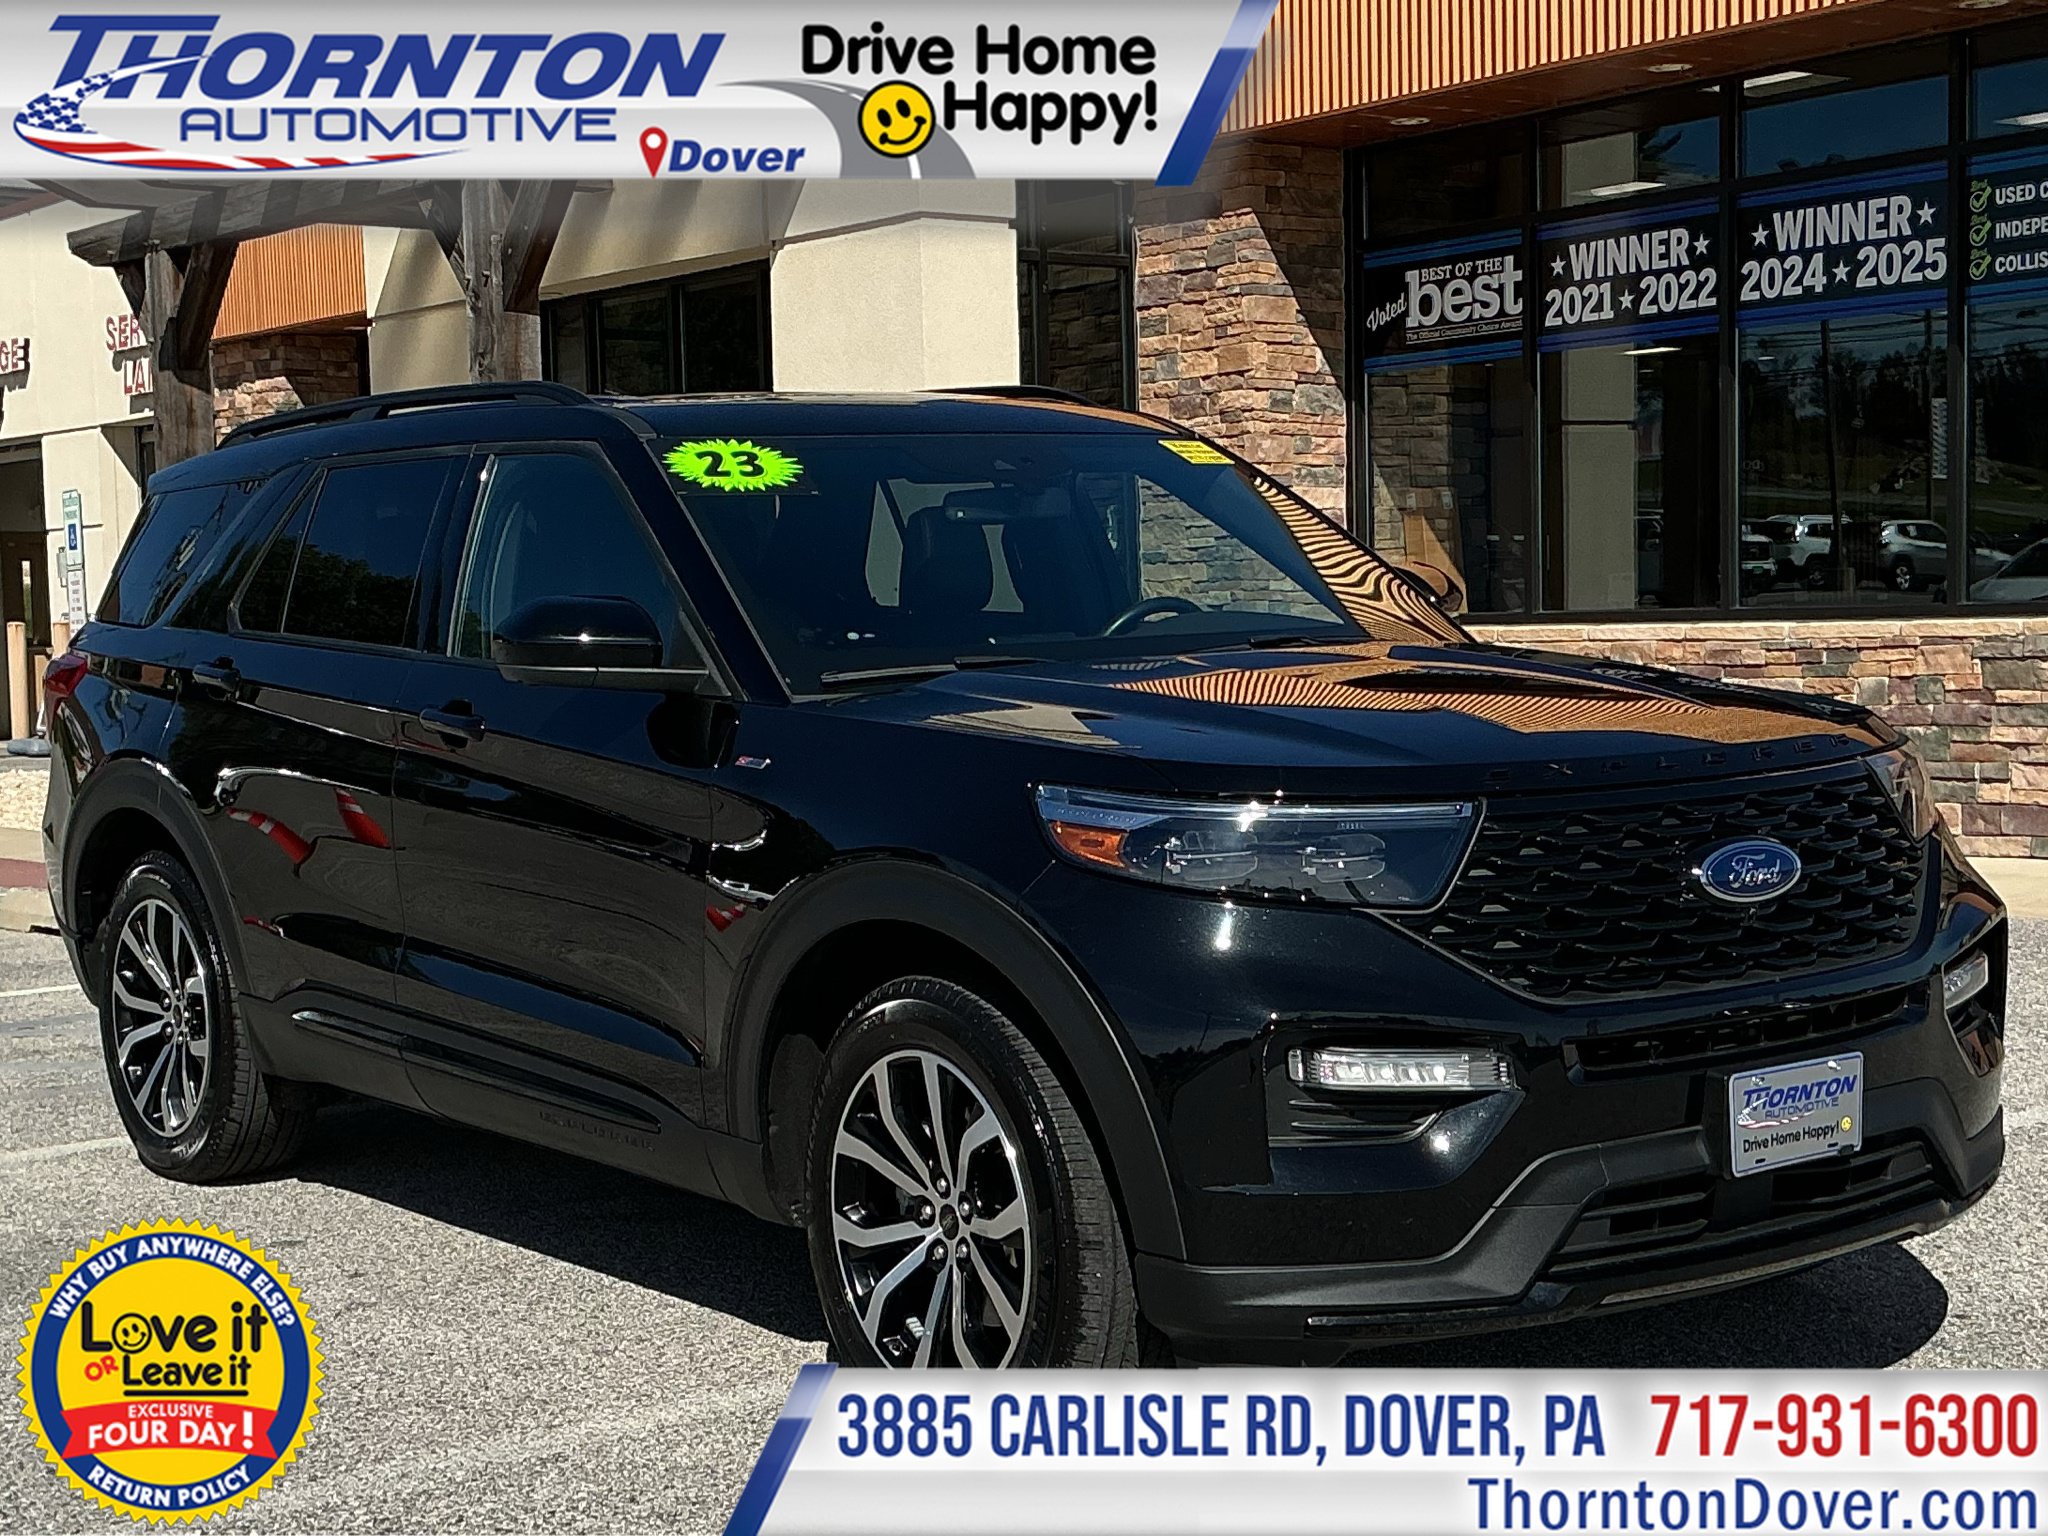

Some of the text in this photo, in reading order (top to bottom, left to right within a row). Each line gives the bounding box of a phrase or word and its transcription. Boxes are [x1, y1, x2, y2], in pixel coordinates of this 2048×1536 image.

[1995, 184, 2036, 205] USED
[1772, 195, 1913, 252] WINNER
[1421, 257, 1503, 283] BEST OF THE
[1568, 227, 1690, 282] WINNER
[1740, 237, 1948, 302] 2024 2025
[1405, 255, 1523, 328] best
[1545, 267, 1717, 327] 2021 2022
[1366, 292, 1407, 332] Voted
[695, 450, 766, 478] 23
[1729, 852, 1781, 888] Ford
[1743, 1075, 1857, 1112] THORNTON
[1765, 1097, 1839, 1120] AUTOMOTIVE
[1743, 1120, 1839, 1153] Drive Home Happy!
